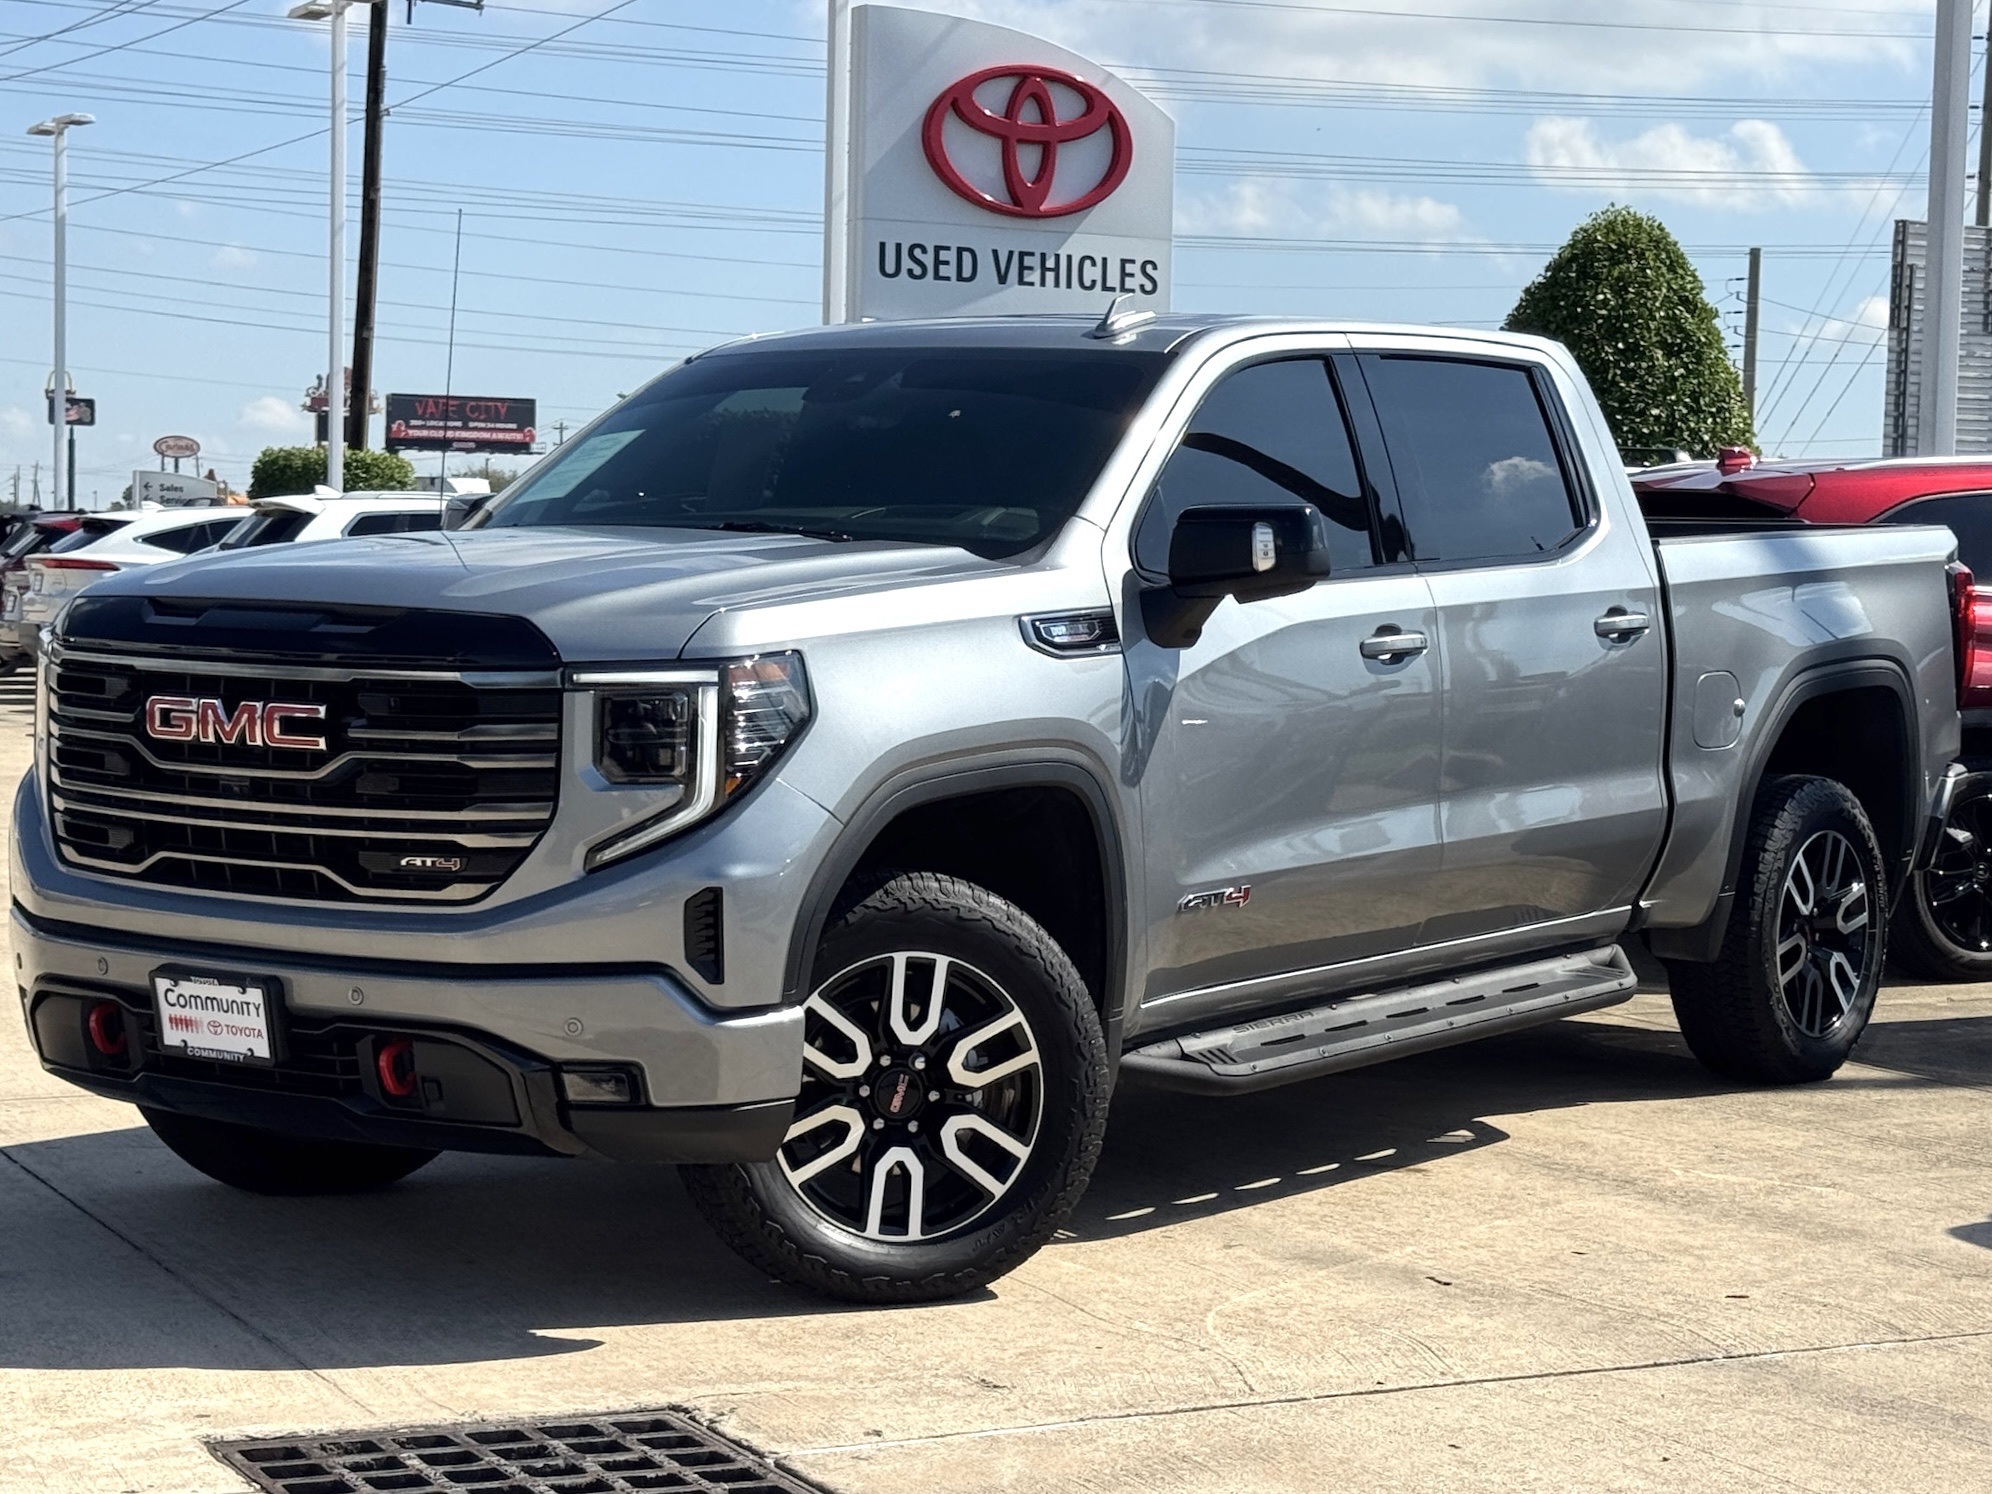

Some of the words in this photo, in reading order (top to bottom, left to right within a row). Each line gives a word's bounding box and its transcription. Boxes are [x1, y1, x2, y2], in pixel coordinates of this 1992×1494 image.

[878, 241, 978, 283] USED
[991, 248, 1159, 296] VEHICLES
[465, 400, 509, 419] CITY
[468, 421, 486, 429] OPEN
[407, 429, 429, 438] YOUR
[455, 431, 491, 440] KINGDOM
[159, 483, 184, 493] Sales
[146, 695, 327, 751] GMC
[400, 856, 460, 871] AT4
[1178, 884, 1251, 912] AT4
[1232, 1011, 1314, 1034] SIERRA
[224, 1024, 264, 1039] TOYOTA
[187, 1047, 245, 1062] COMMUNITY
